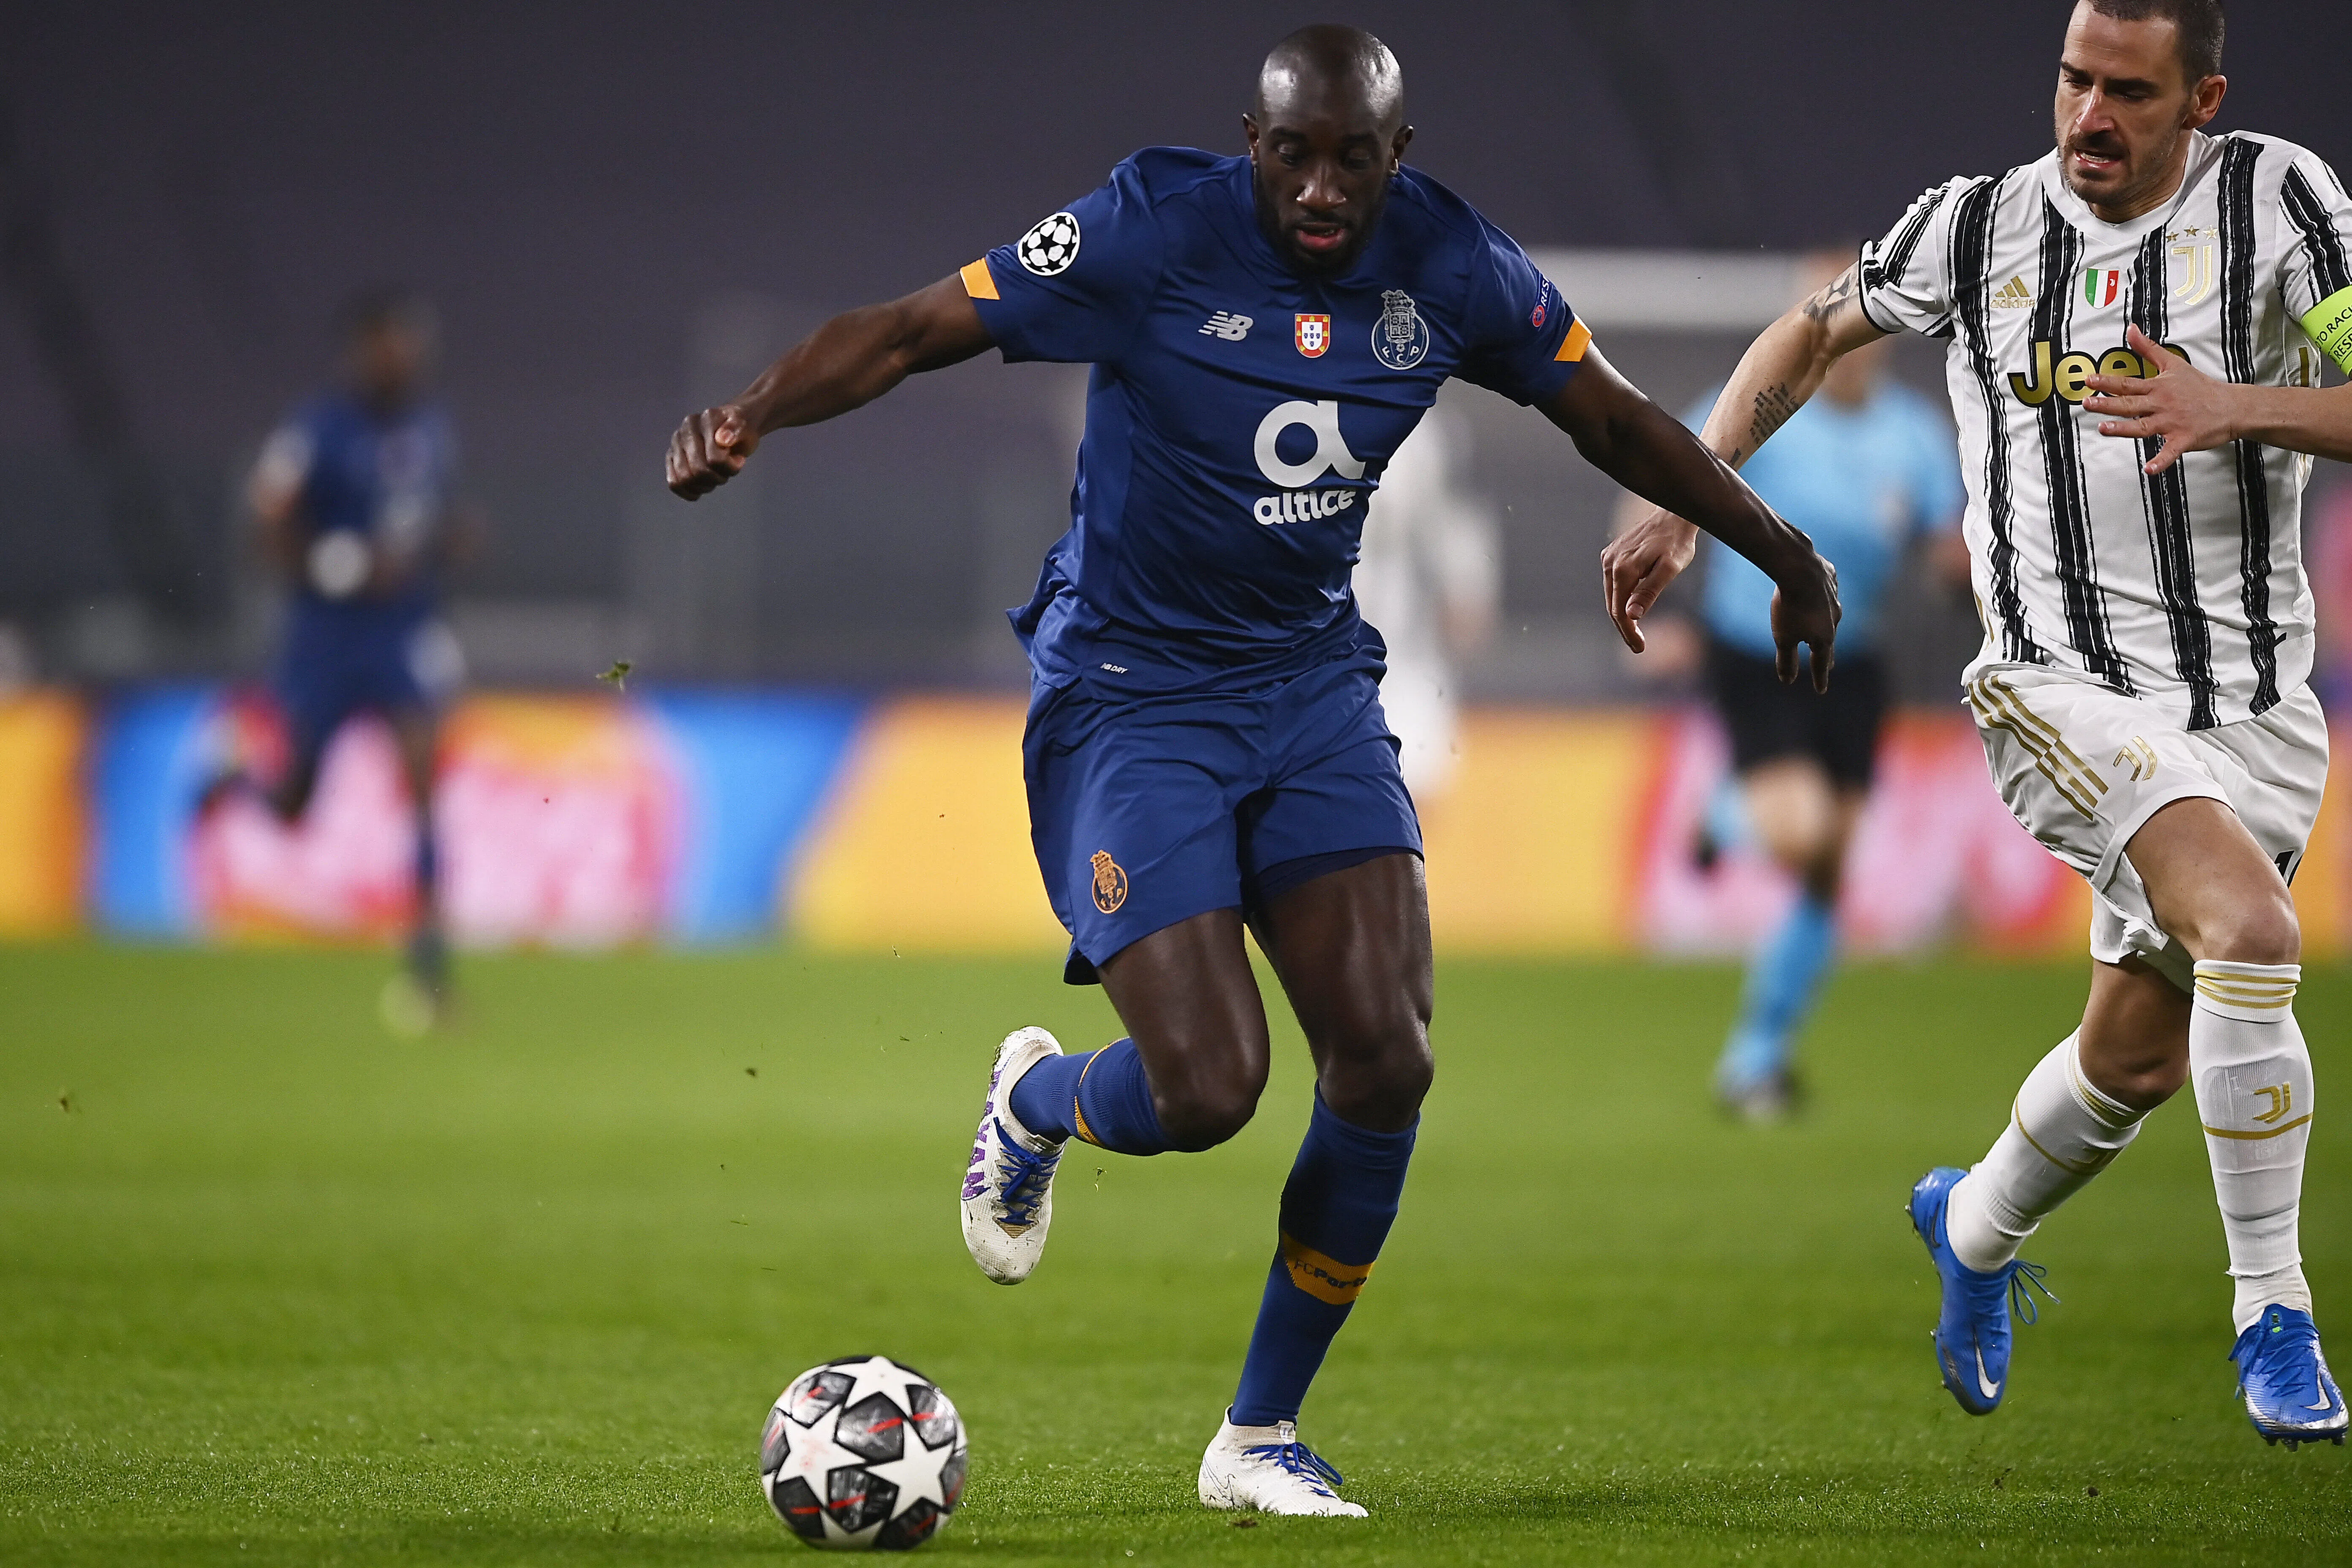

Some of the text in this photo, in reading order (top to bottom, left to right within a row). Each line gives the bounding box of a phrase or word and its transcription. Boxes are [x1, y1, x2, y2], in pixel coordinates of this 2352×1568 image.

[1990, 296, 2035, 308] adidas
[2326, 305, 2352, 334] RACI
[2007, 339, 2191, 406] Jee
[1253, 490, 1356, 525] altice
[1110, 665, 1128, 674] DRY
